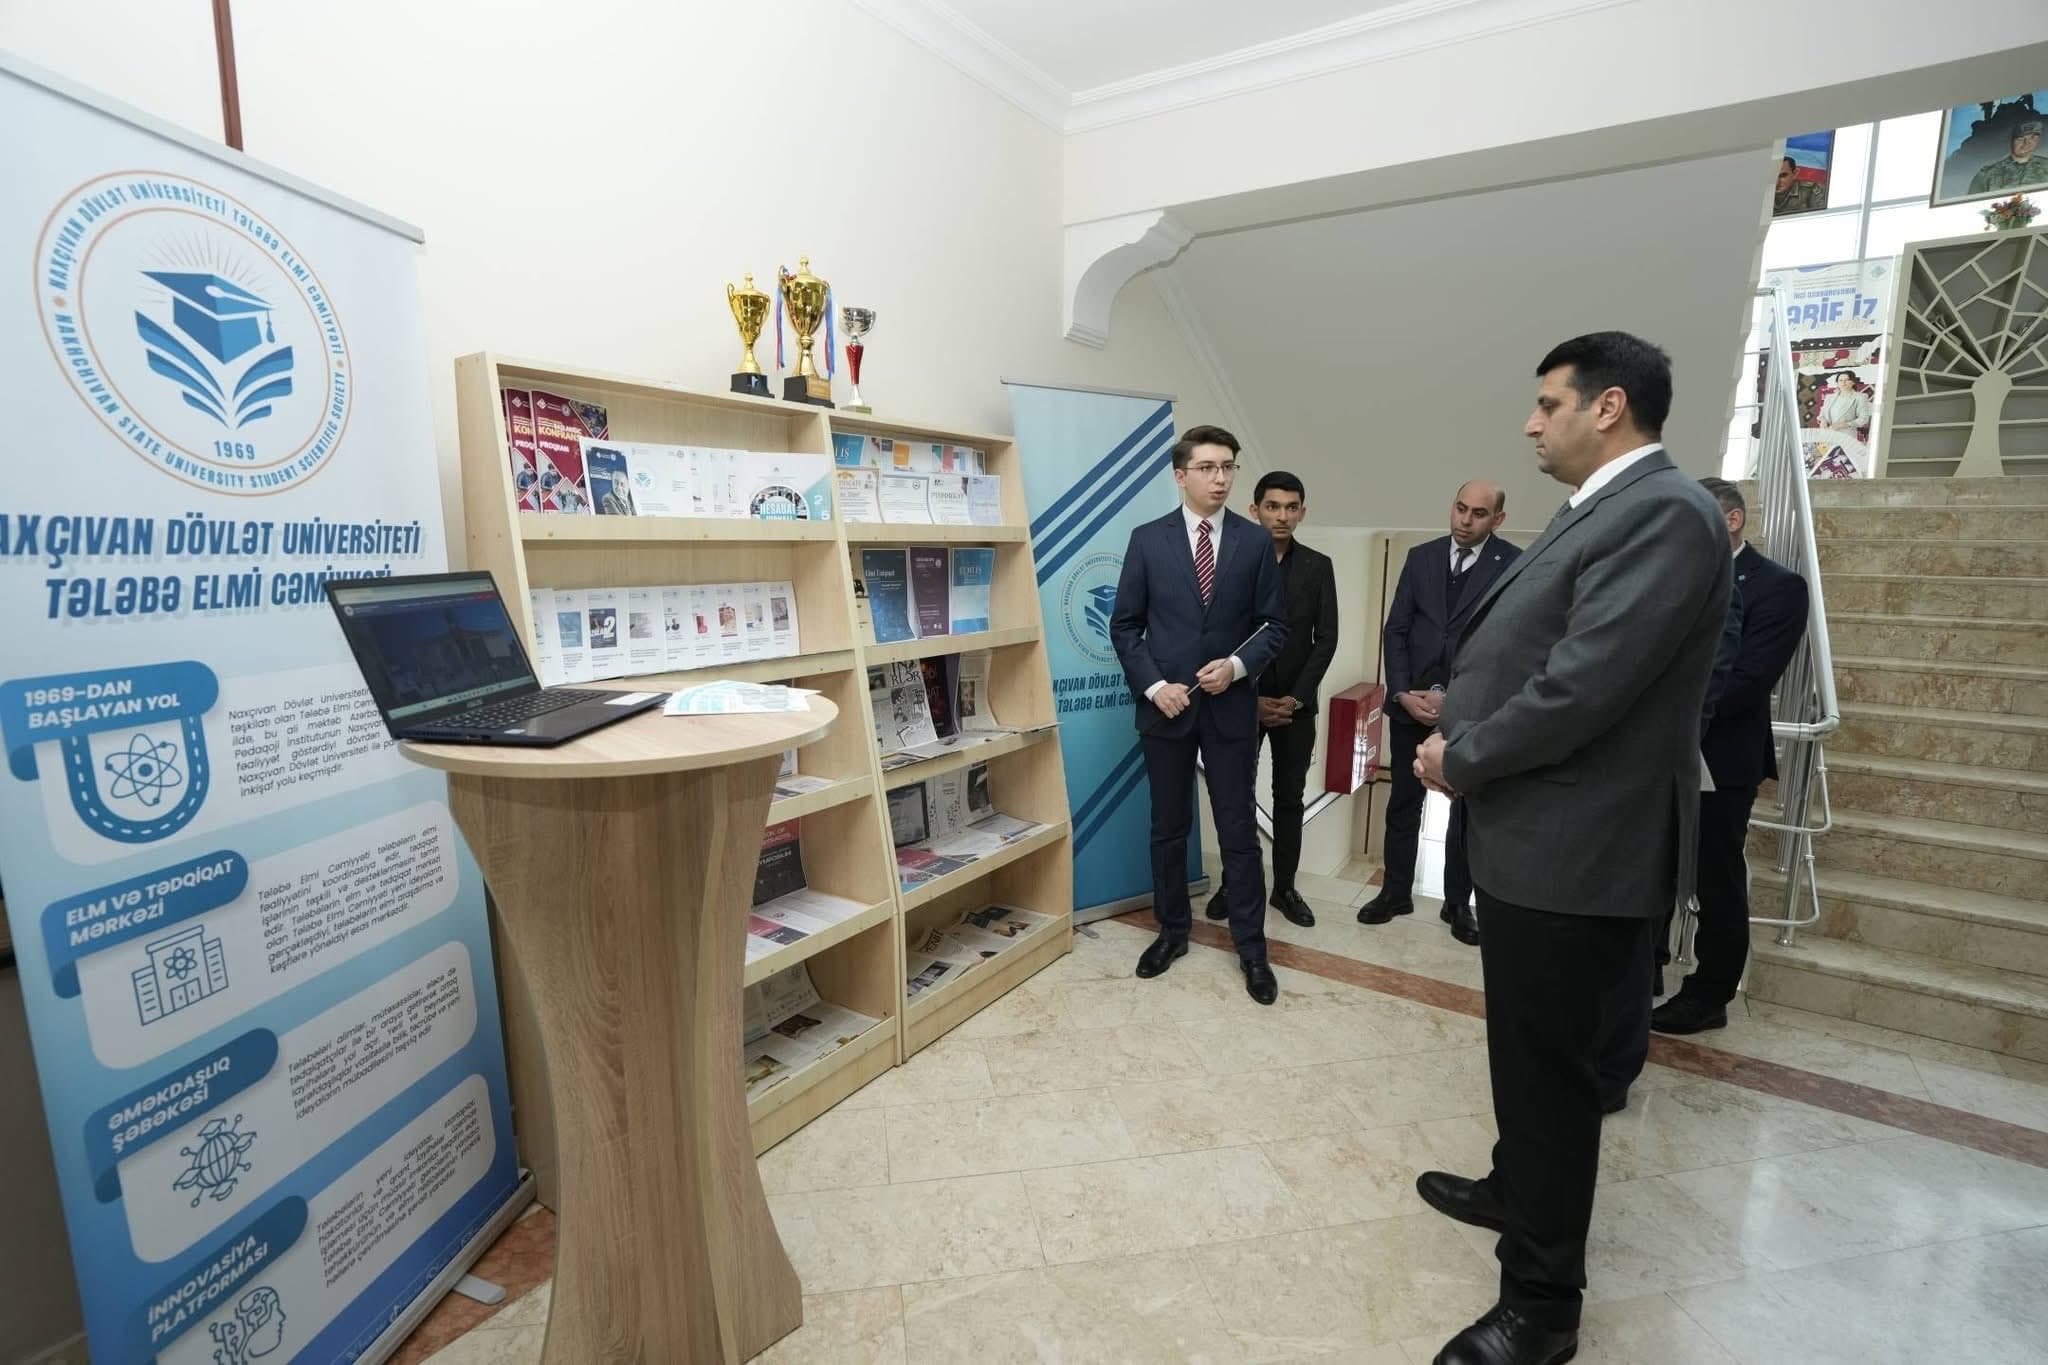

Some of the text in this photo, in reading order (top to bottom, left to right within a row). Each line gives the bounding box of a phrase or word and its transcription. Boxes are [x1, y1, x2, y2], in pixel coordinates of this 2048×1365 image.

[49, 180, 344, 354] NAXÇIVAN DÖVLƏT UNİVERSİTETİ TƏLƏBƏ ELMİ CƏMİYYƏTİ
[1771, 298, 1844, 330] ƏRİF
[55, 314, 346, 489] NAKHCHIVAN STATE UNIVERSITY STUDENT SCIENTIFIC SOCIETY
[213, 439, 256, 460] 1969
[167, 512, 274, 555] DÖVLƏT
[283, 517, 421, 555] UNİVERSİTETİ
[46, 575, 181, 619] TƏLƏBƏ
[193, 566, 263, 610] ELMİ
[24, 679, 133, 708] 1969-DAN
[1088, 672, 1121, 690] DÖVLƏT
[28, 693, 181, 730] BAŞLAYAN YOL
[228, 705, 275, 718] Naxçıvan
[283, 697, 313, 709] Dövlət
[230, 718, 270, 732] təşkilatı
[274, 714, 295, 724] olan
[300, 707, 329, 718] Tələbə
[332, 702, 350, 712] Elmi
[1058, 696, 1092, 713] TƏLƏBƏ
[1095, 691, 1117, 709] ELMİ
[264, 730, 277, 739] bu
[286, 724, 298, 734] ali
[307, 717, 341, 728] məktəb
[234, 742, 279, 757] Pedaqoji
[236, 731, 379, 770] fəaliyyət göstərdiyi dövrdən
[238, 766, 284, 782] Naxçıvan
[289, 757, 318, 771] Dövlət
[240, 780, 273, 796] inkişaf
[276, 776, 296, 789] yolu
[66, 858, 236, 927] ELM VƏ TƏDQİQAT
[70, 898, 165, 947] MƏRKƏZİ
[107, 1055, 231, 1131] ƏMƏKDAŞLIQ
[111, 1083, 210, 1155] ŞƏBƏKƏSİ
[147, 1234, 257, 1326] İNNOVASİYA
[151, 1241, 269, 1344] PLATFORMASI
